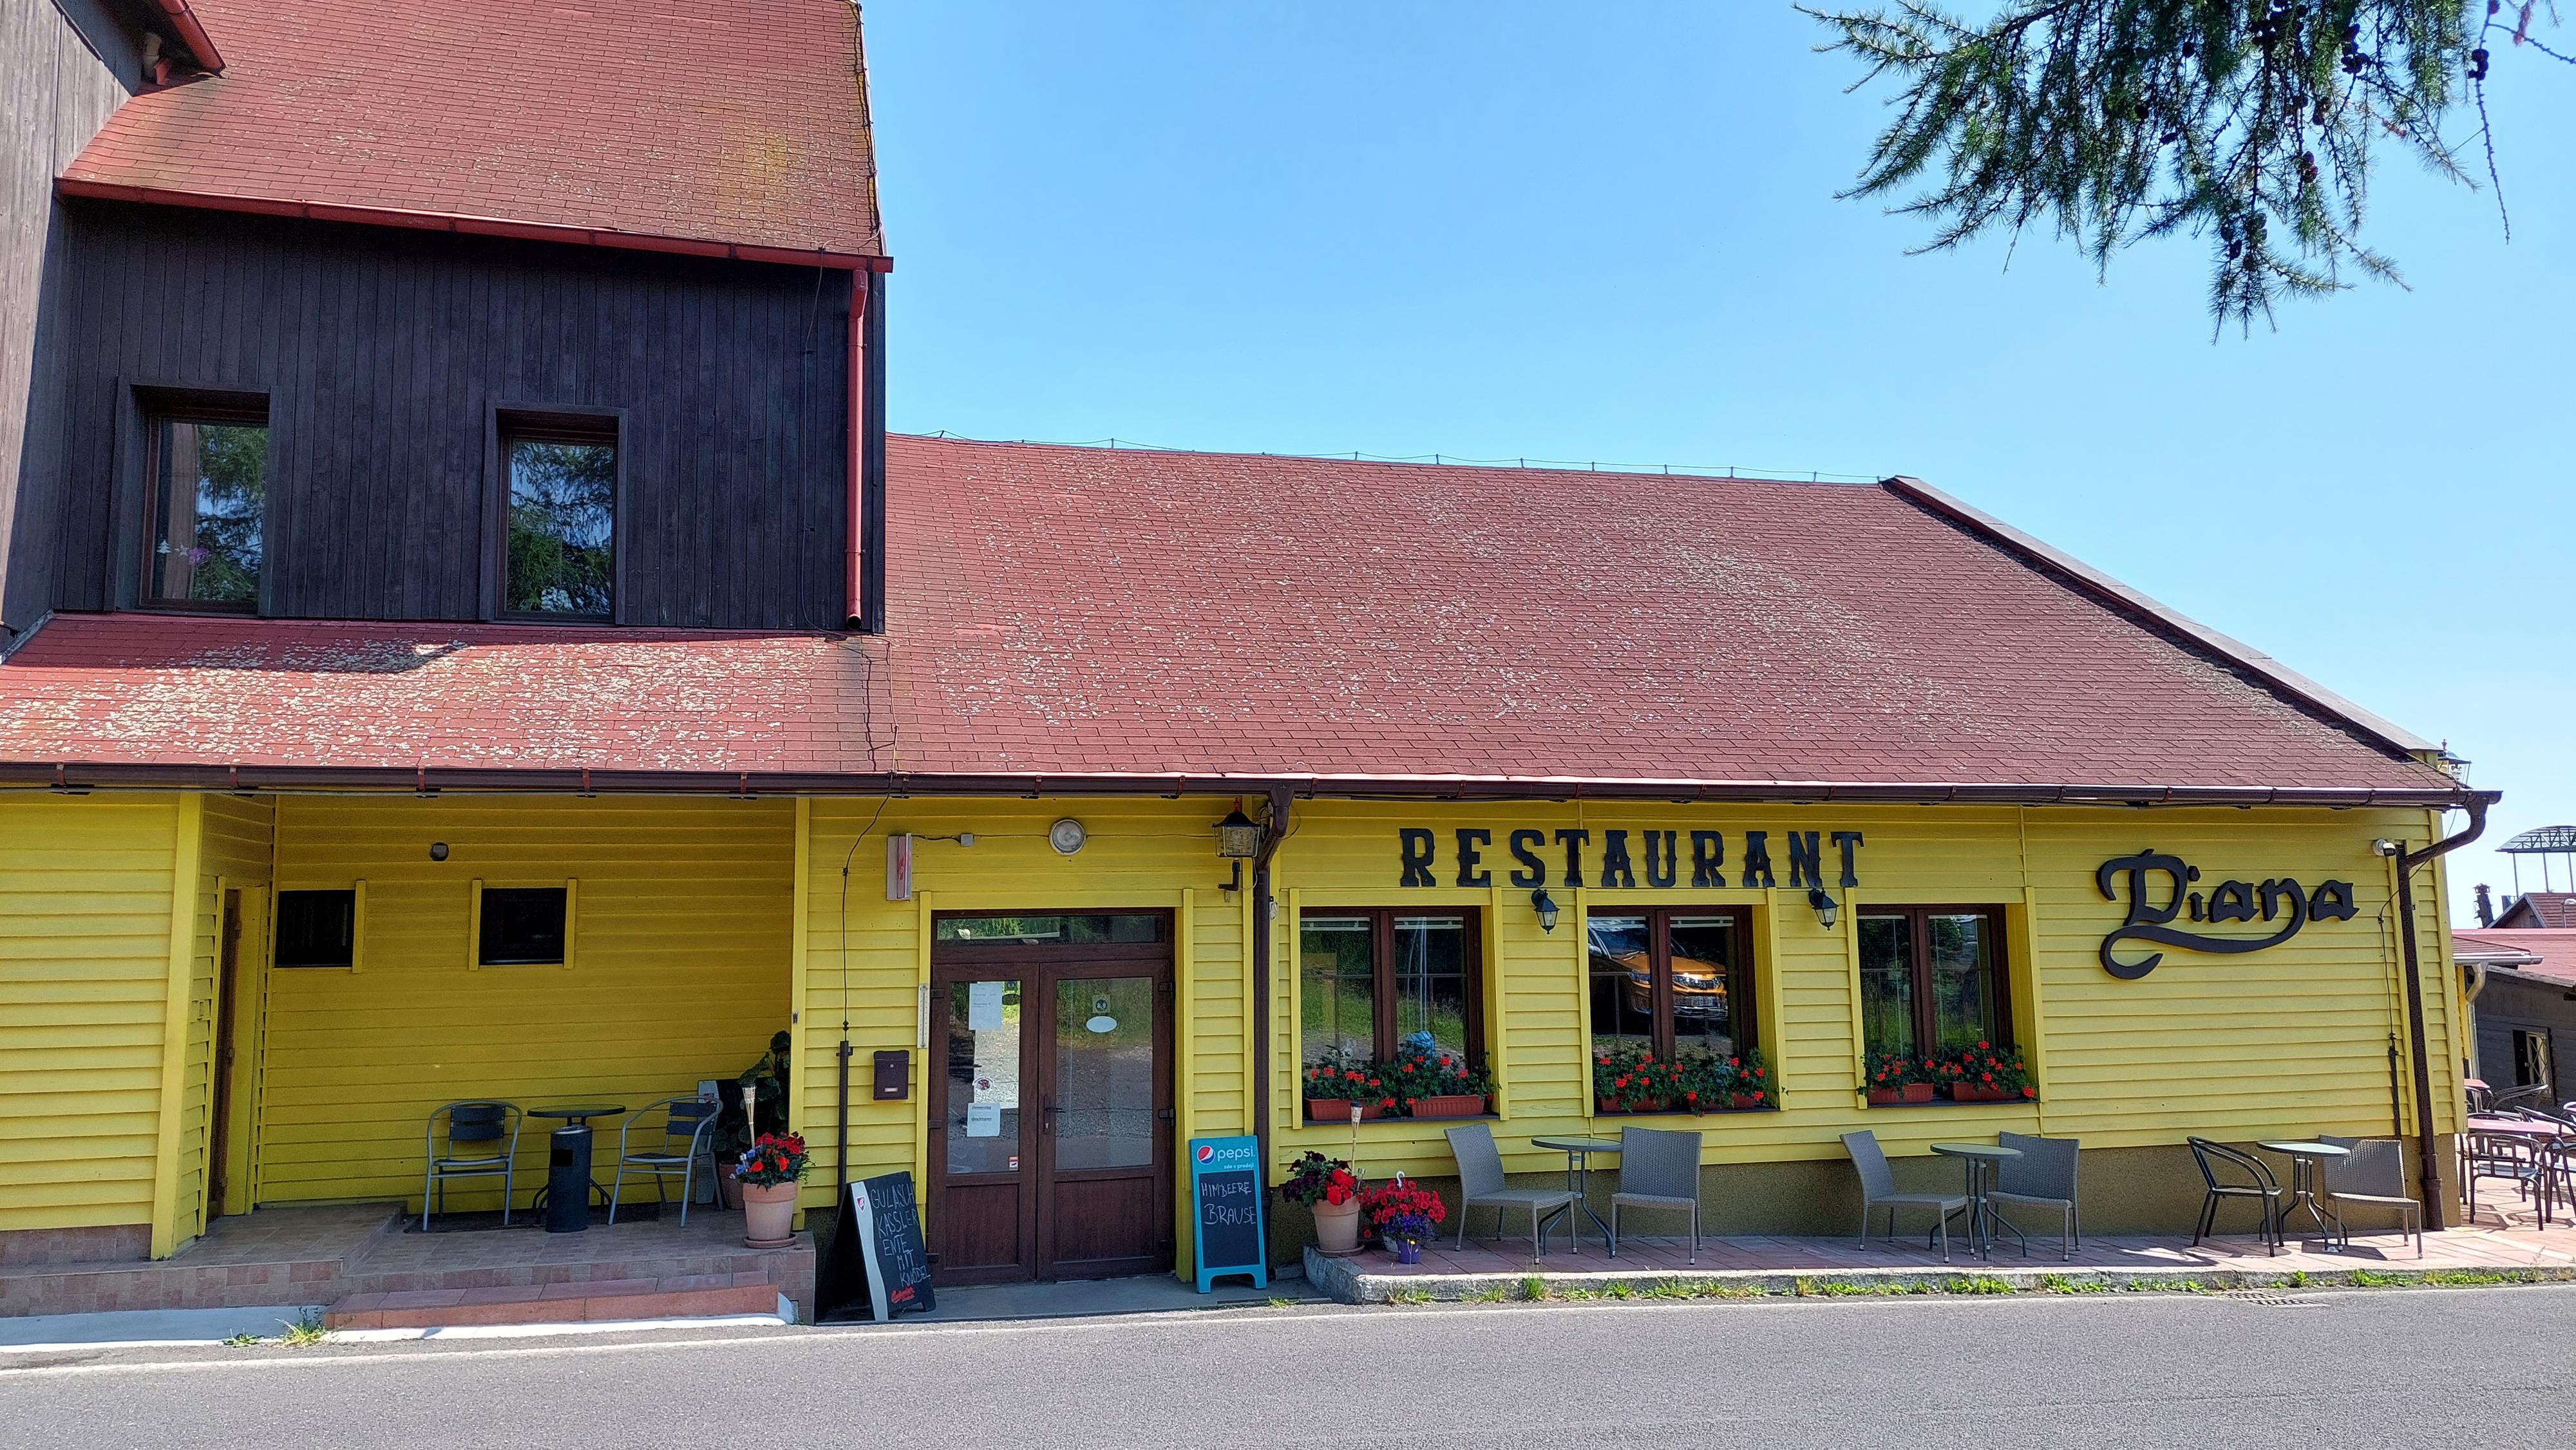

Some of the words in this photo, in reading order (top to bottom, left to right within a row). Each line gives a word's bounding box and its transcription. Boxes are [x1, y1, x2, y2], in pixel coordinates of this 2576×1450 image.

[1399, 828, 1864, 887] RESTAURANT
[2096, 849, 2360, 980] Diana
[1217, 1145, 1253, 1162] pepsi
[871, 1183, 914, 1209] GULASCH
[1200, 1182, 1252, 1198] HIMBEERE
[875, 1209, 918, 1239] KASSLER
[1204, 1203, 1256, 1225] BRAUSE
[882, 1233, 909, 1256] ENTE
[896, 1248, 914, 1271] MIT
